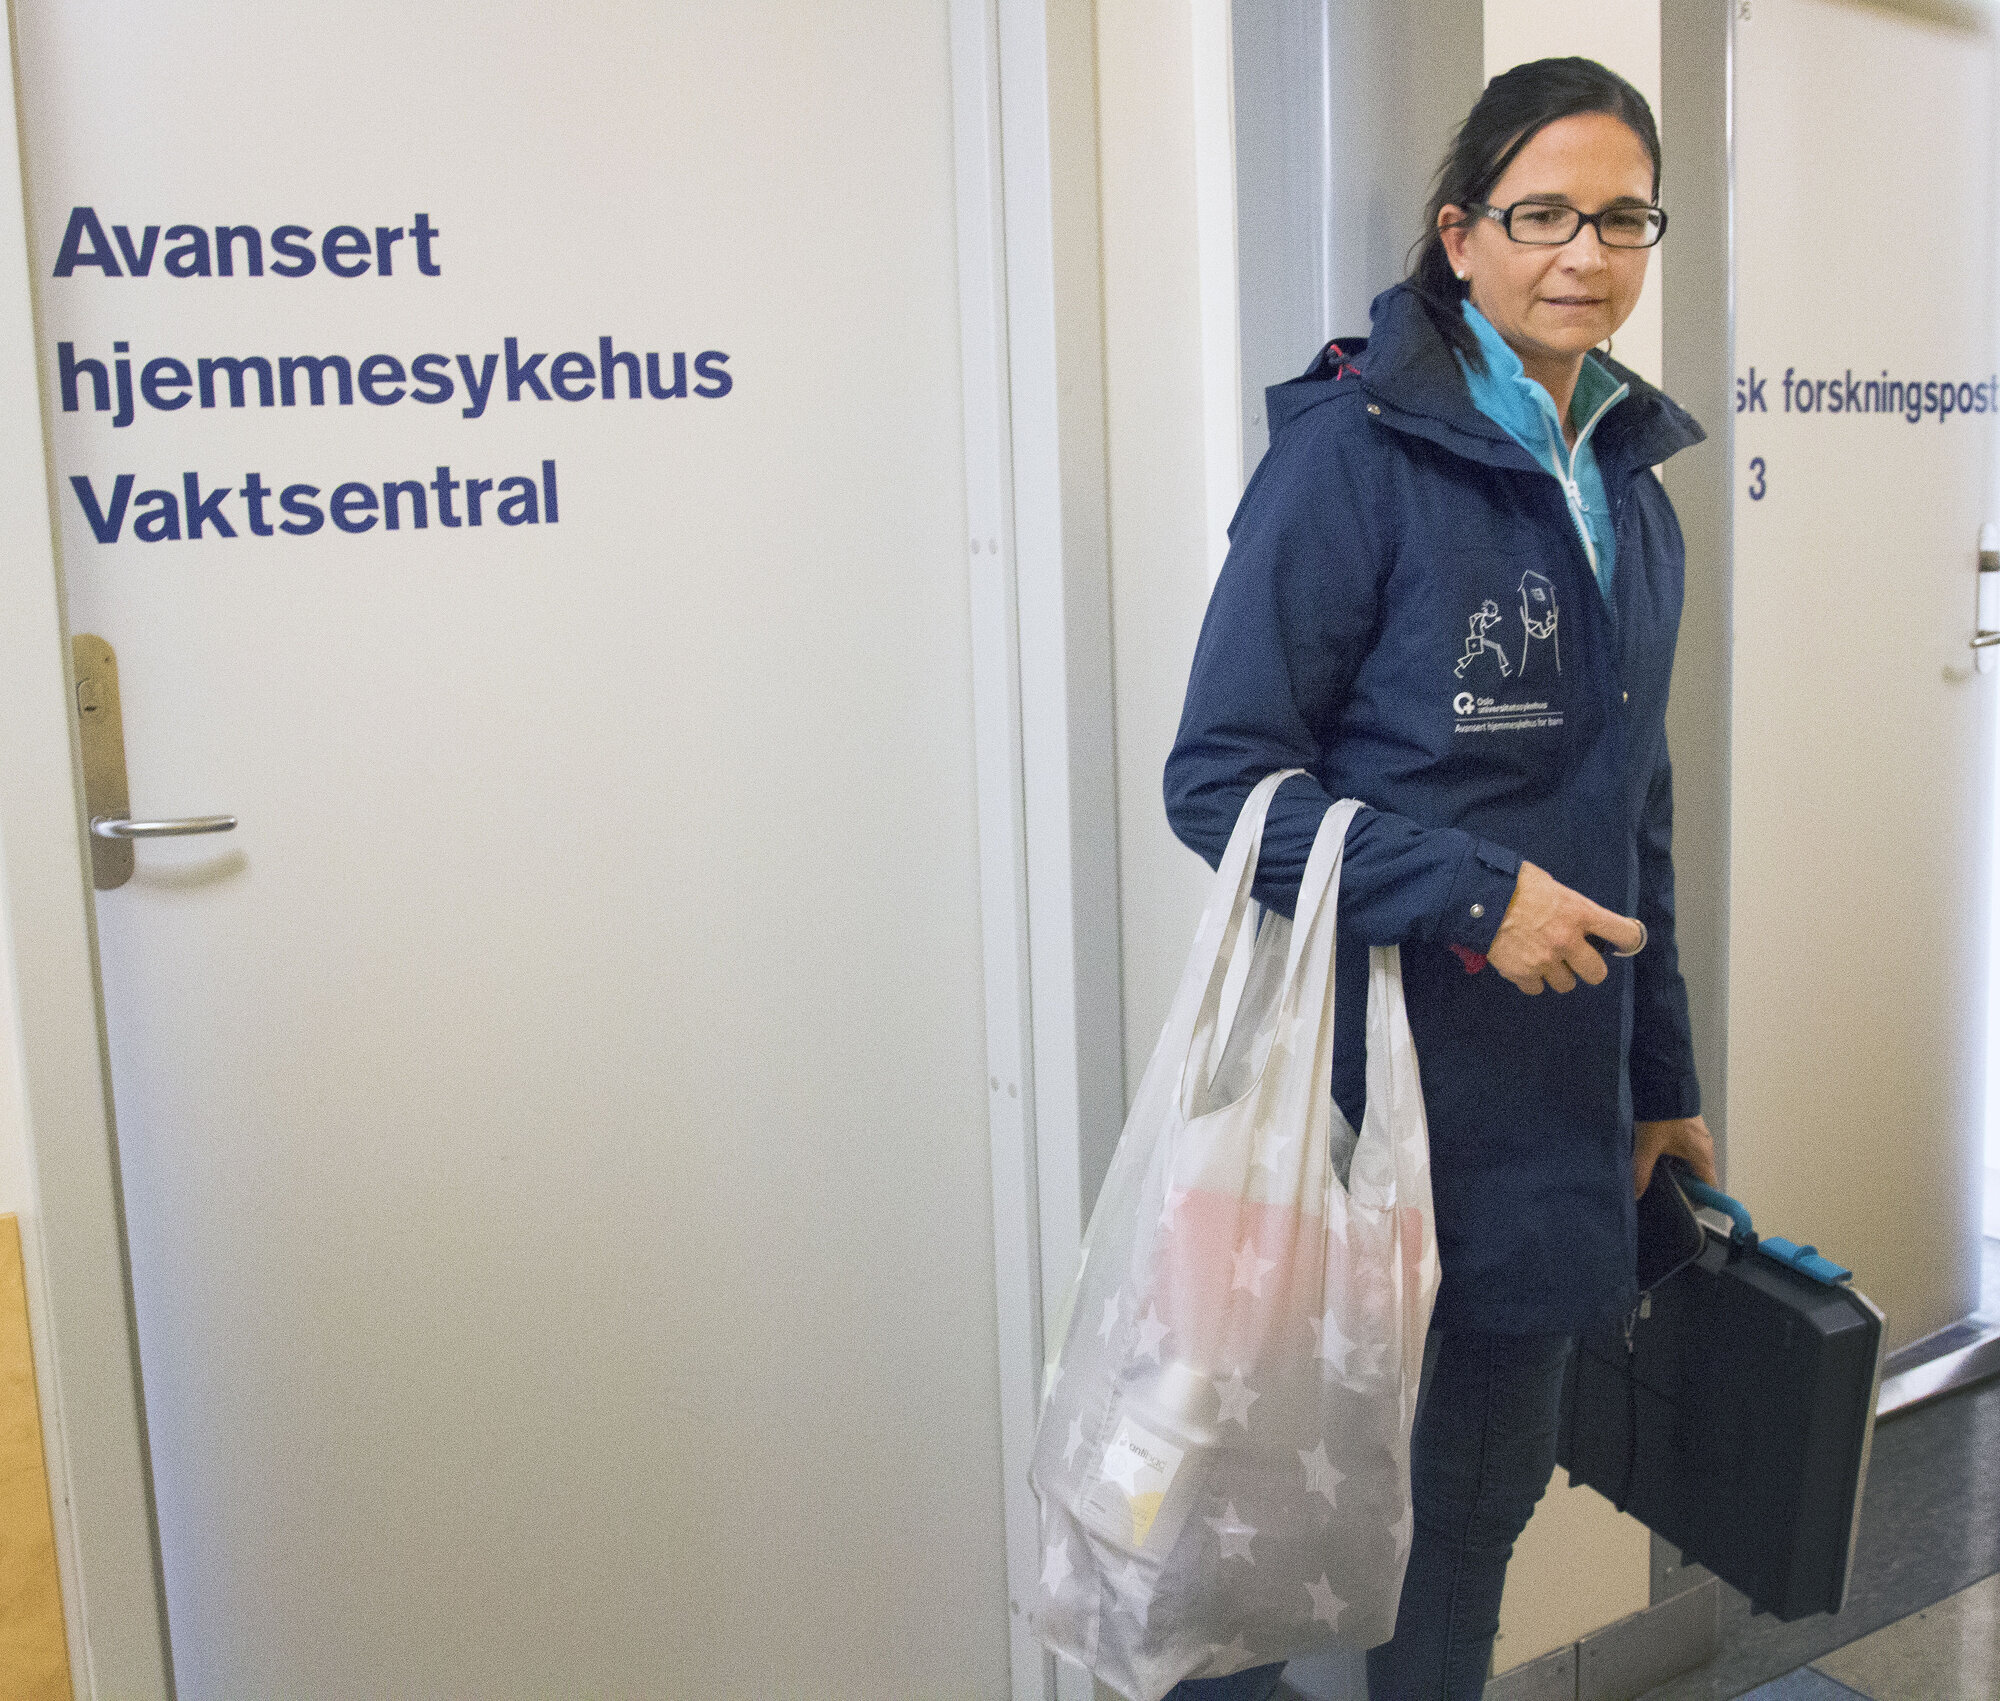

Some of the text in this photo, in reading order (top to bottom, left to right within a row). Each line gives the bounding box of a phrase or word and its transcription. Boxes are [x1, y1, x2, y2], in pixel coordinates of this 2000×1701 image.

[52, 207, 441, 278] Avansert
[57, 336, 734, 428] hjemmesykehus
[1782, 366, 1999, 424] forskningspost
[69, 459, 560, 545] Vaktsentral
[1748, 456, 1767, 501] 3
